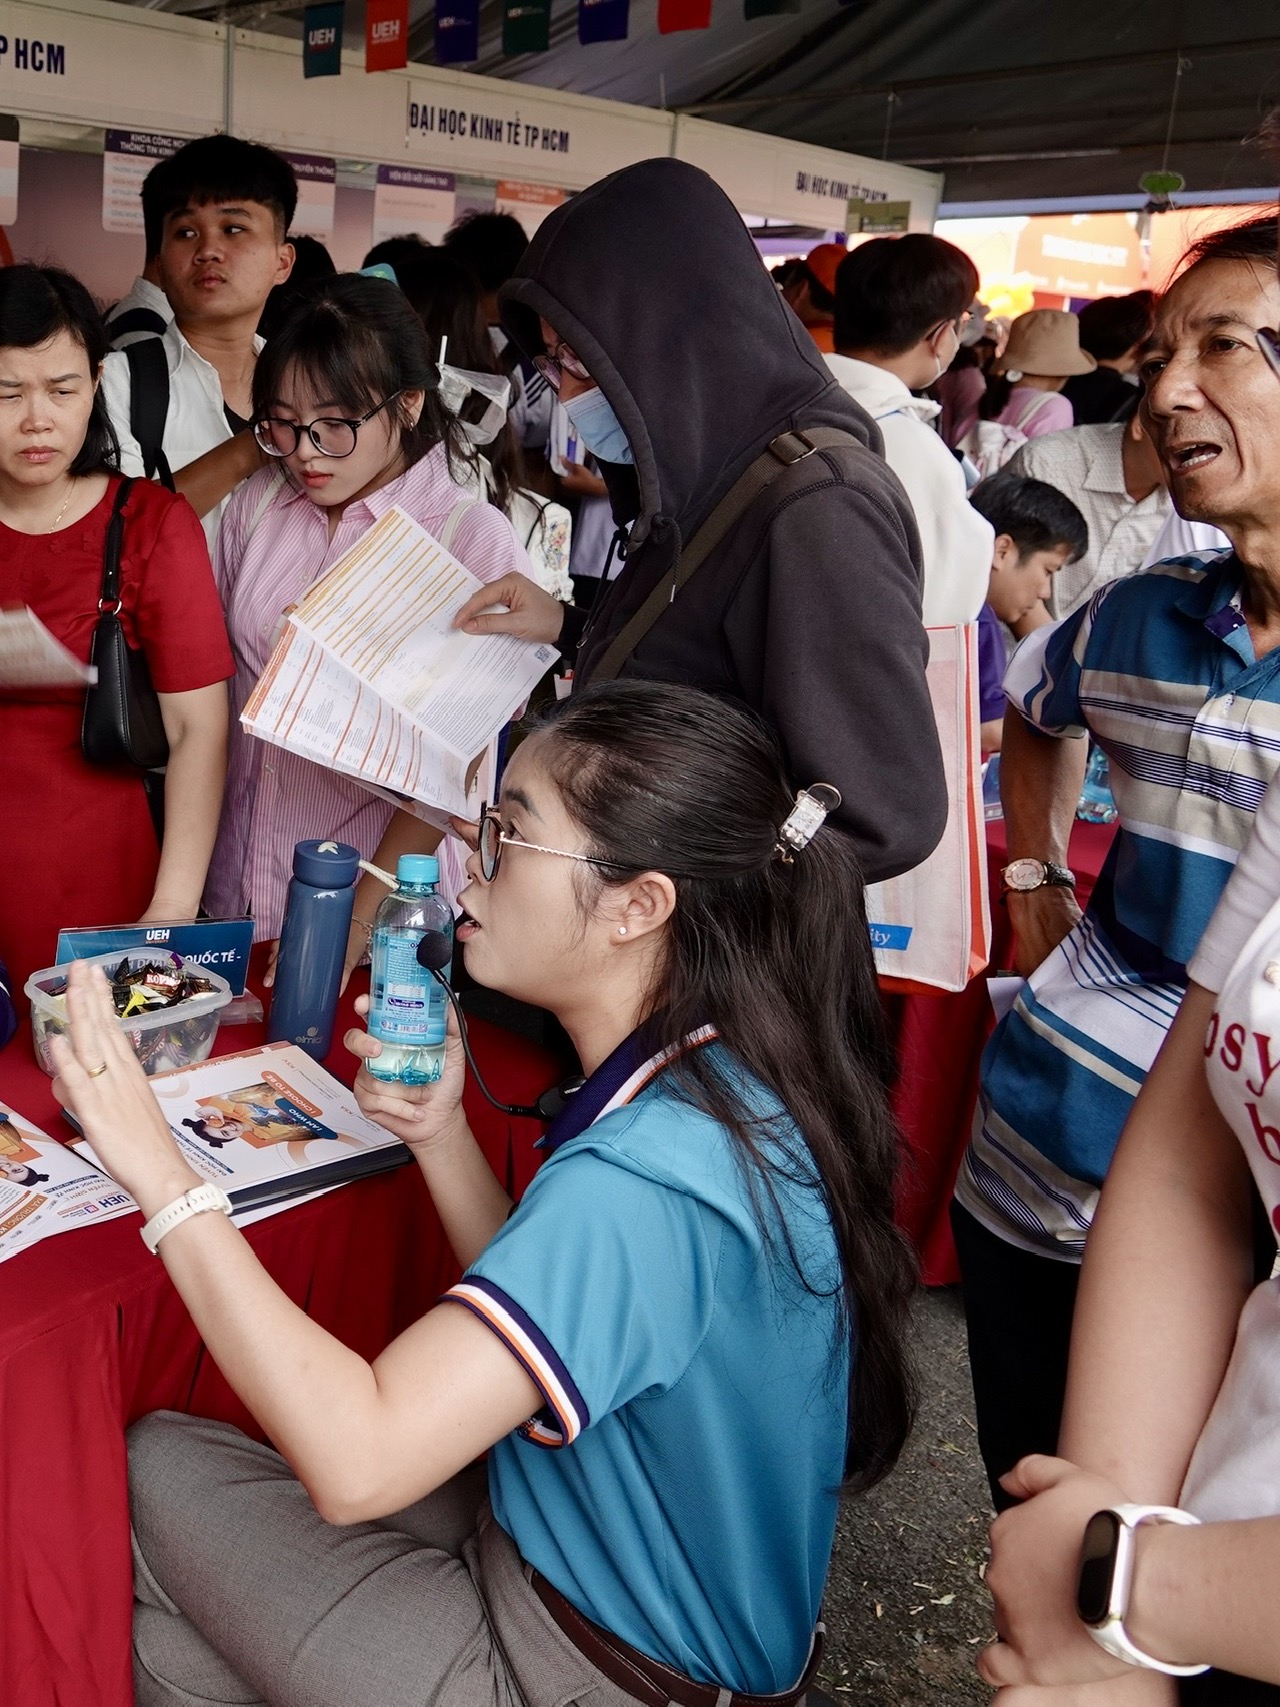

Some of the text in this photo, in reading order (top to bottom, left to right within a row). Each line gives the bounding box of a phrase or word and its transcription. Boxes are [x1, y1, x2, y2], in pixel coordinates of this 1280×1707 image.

[309, 28, 335, 45] UEH
[372, 20, 400, 38] UEH
[14, 37, 65, 75] HCM
[410, 103, 569, 153] ĐẠI HỌC KINH TẾ TP HCM
[145, 929, 169, 940] UEH
[220, 948, 236, 962] TẾ
[288, 1108, 307, 1123] WHO
[98, 1194, 131, 1208] UEH
